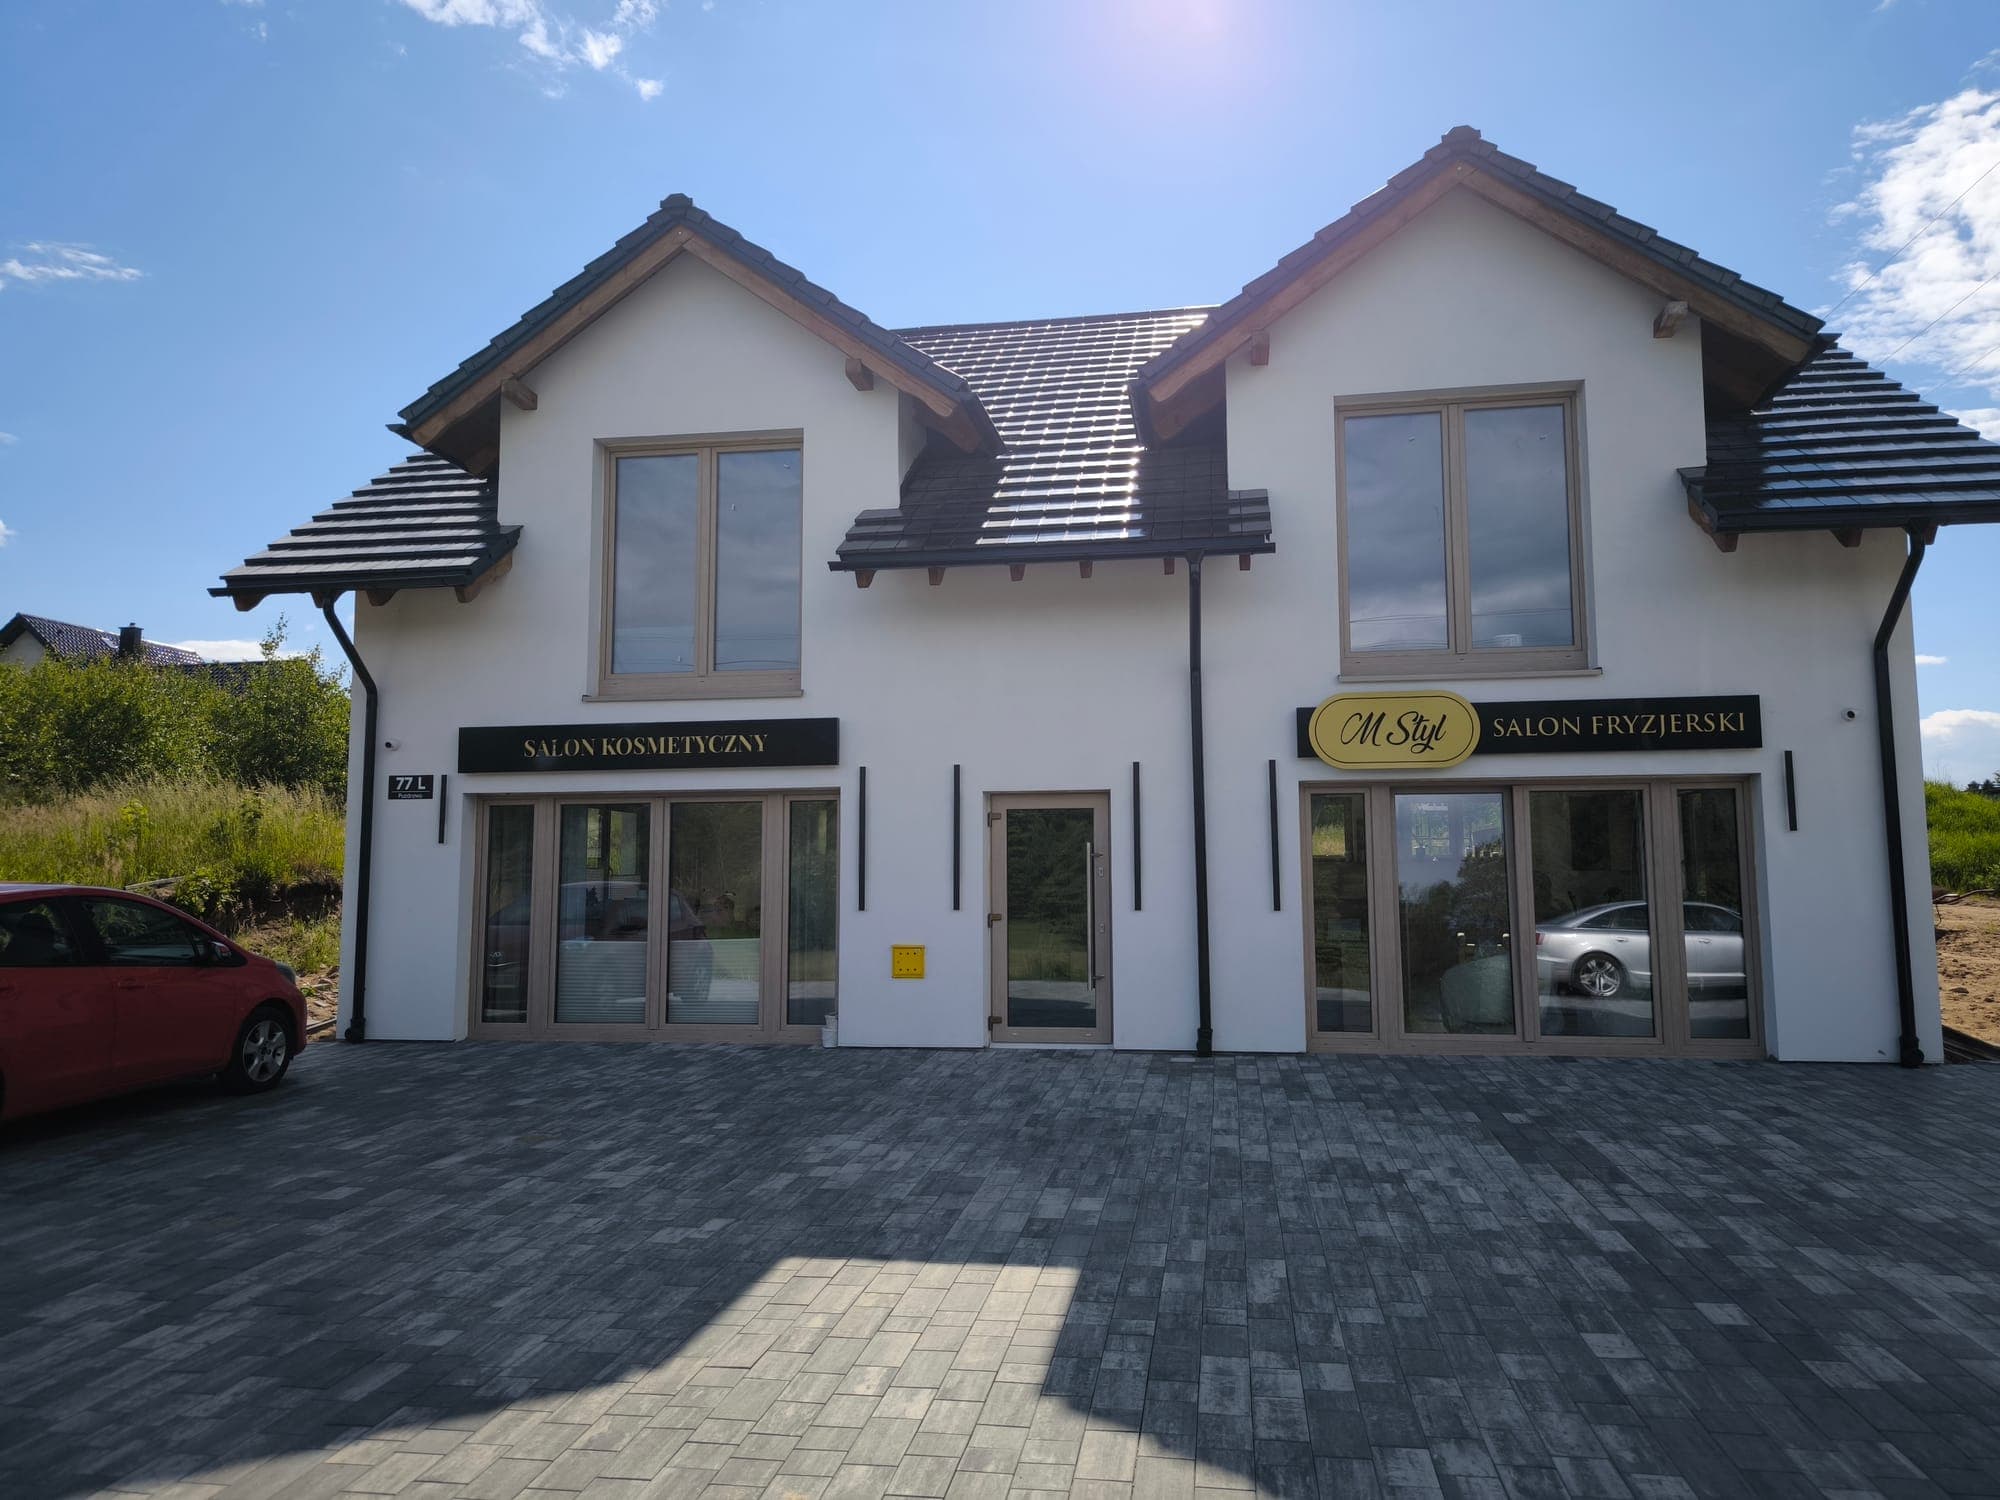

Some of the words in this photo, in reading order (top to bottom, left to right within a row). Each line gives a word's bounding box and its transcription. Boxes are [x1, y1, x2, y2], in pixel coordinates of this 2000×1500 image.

[1340, 711, 1383, 747] M
[1386, 711, 1447, 754] Styl
[1493, 715, 1582, 738] SALON
[1592, 712, 1746, 739] FRYZJERSKI
[523, 738, 595, 758] SALON
[602, 734, 769, 755] KOSMETYCZNY
[396, 777, 413, 790] 77
[418, 776, 426, 790] L
